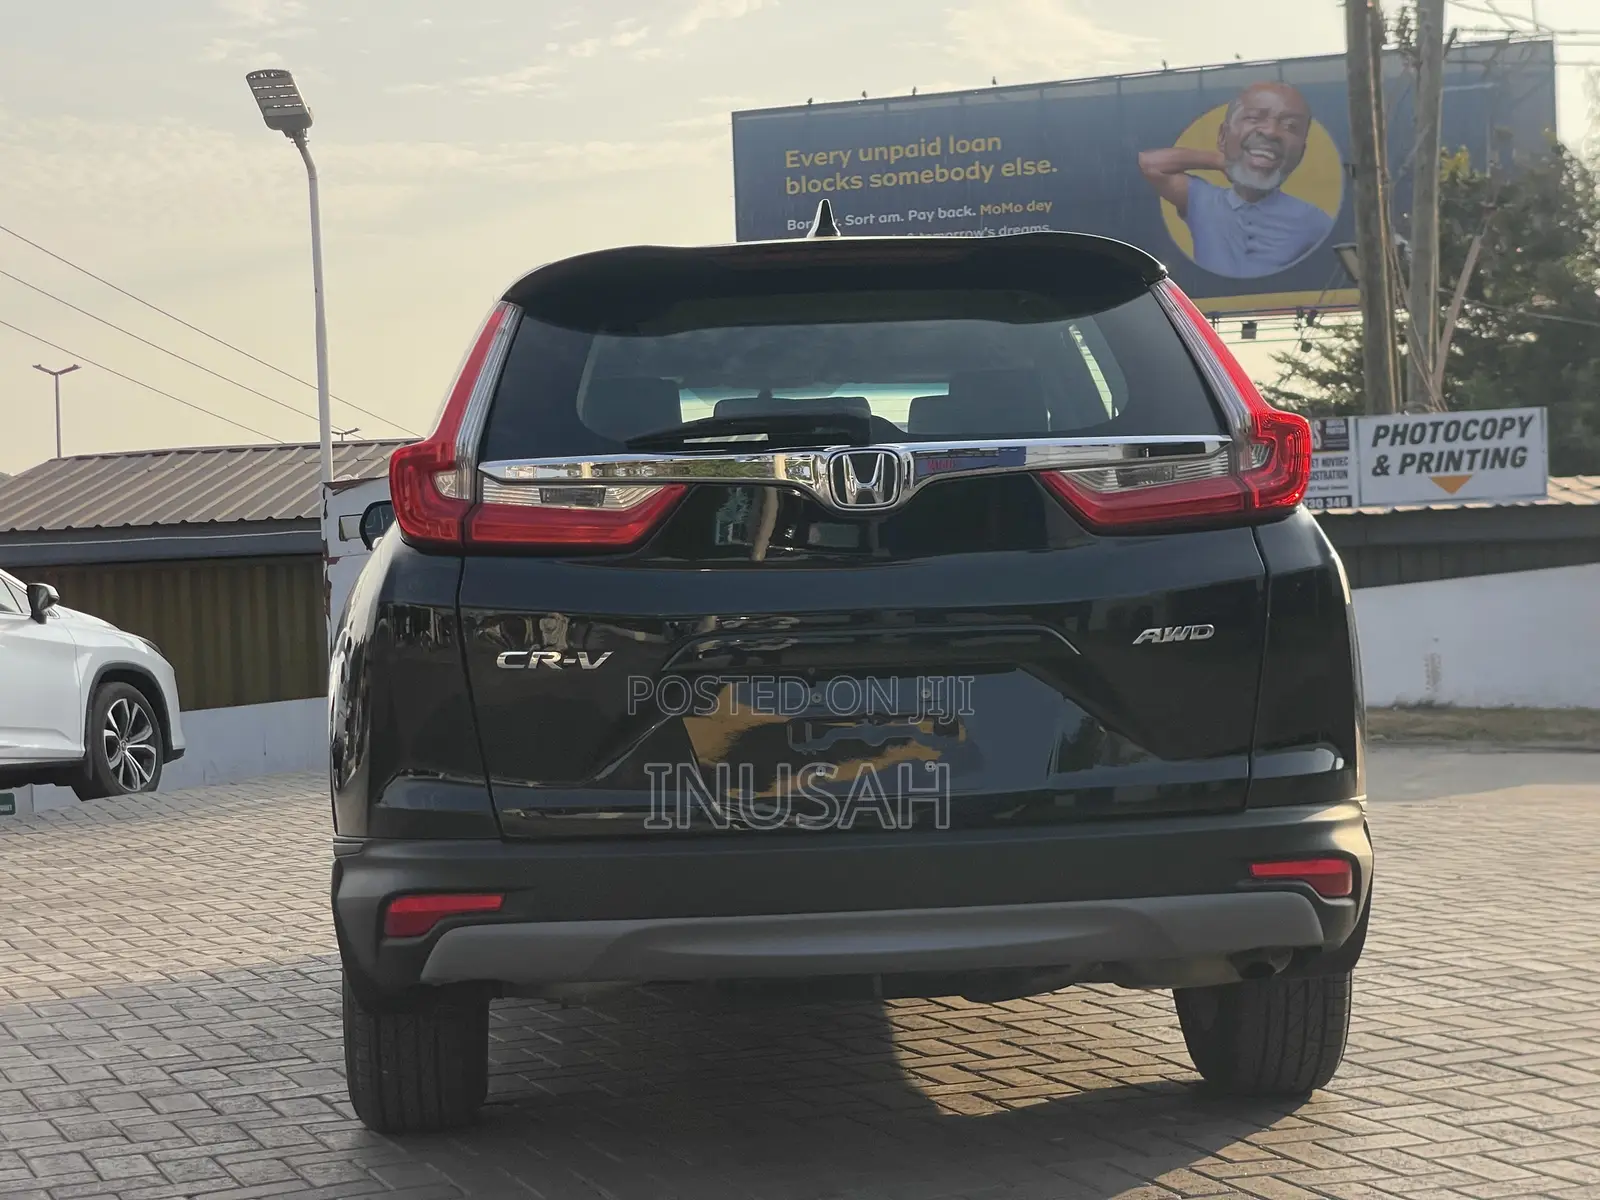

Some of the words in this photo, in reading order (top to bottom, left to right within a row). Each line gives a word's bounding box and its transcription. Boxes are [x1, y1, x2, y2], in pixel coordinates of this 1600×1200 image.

[785, 147, 851, 168] Every
[858, 136, 941, 163] unpaid
[949, 135, 1001, 154] loan
[786, 172, 863, 195] blocks
[869, 163, 994, 188] somebody
[1001, 157, 1058, 177] else.
[787, 217, 842, 231] Bor.
[845, 213, 875, 226] Sort
[878, 213, 904, 224] am.
[908, 209, 934, 222] Pay
[938, 205, 976, 219] back.
[980, 203, 1022, 215] MoMo
[1026, 200, 1052, 213] dey
[1371, 415, 1534, 448] PHOTOCOPY
[1371, 454, 1390, 477] &
[1398, 446, 1528, 475] PRINTING
[1132, 623, 1215, 644] AWD
[496, 651, 614, 670] CR-V
